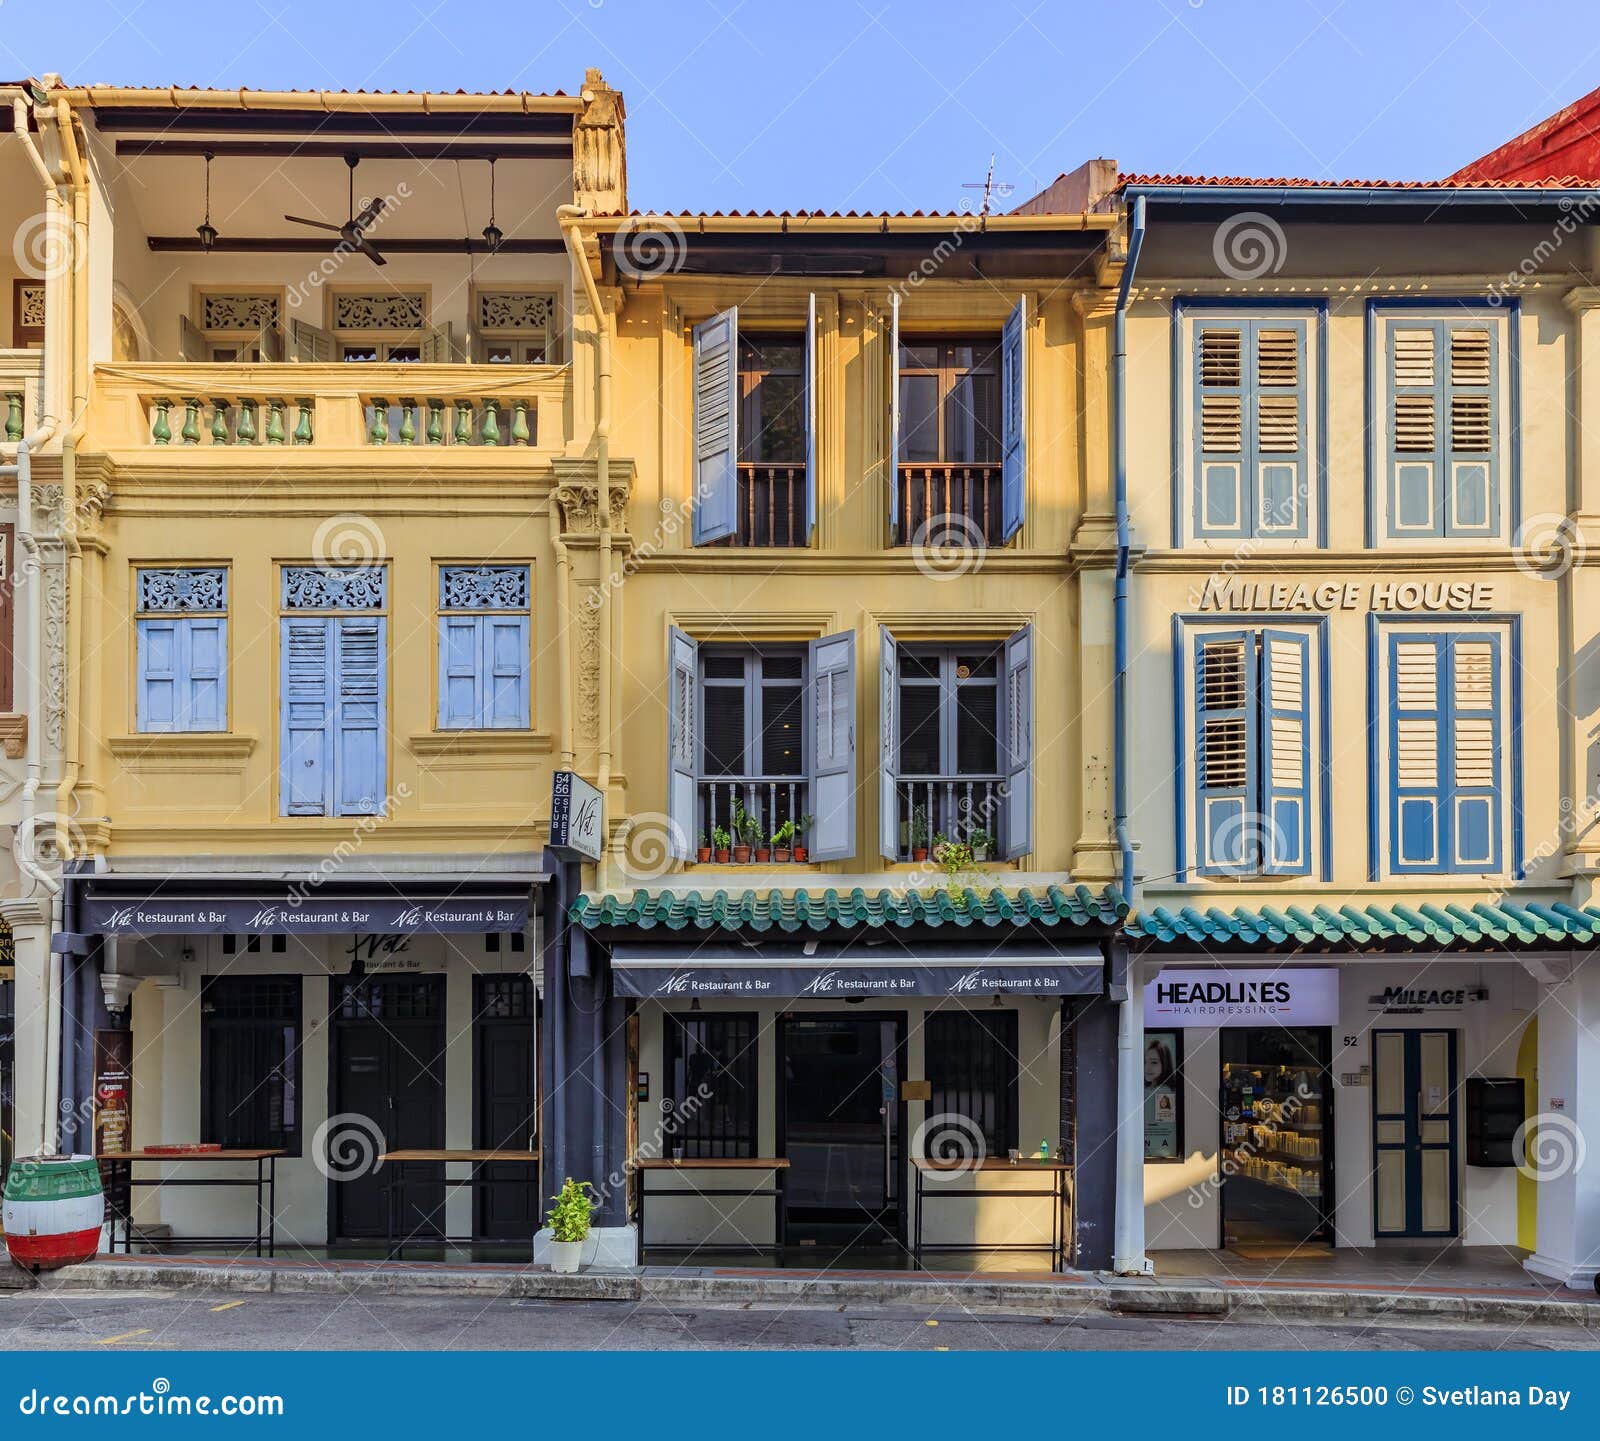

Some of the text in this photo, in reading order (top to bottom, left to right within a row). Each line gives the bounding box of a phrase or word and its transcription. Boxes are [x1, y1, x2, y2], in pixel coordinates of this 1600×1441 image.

[1370, 582, 1496, 611] HOUSE
[556, 773, 569, 784] 54
[555, 784, 569, 794] 56
[552, 798, 561, 829] CLUB
[560, 798, 569, 845] STREET
[137, 912, 195, 923] Restaurant
[198, 912, 206, 923] &
[209, 912, 227, 923] Bar
[281, 911, 339, 923] Restaurant
[341, 911, 350, 923] &
[352, 911, 370, 923] Bar
[425, 911, 482, 922] Restaurant
[485, 911, 494, 922] &
[497, 911, 515, 922] Bar
[691, 981, 742, 990] Restaurant
[745, 980, 753, 989] &
[755, 980, 771, 989] Bar
[837, 979, 888, 989] Restaurant
[890, 979, 898, 988] &
[900, 979, 916, 988] Bar
[982, 978, 1032, 988] Restaurant
[1034, 978, 1042, 987] &
[1044, 978, 1060, 987] Bar
[1157, 982, 1291, 1004] HEADLINES
[1173, 1006, 1277, 1015] HAIRDRESSING
[1343, 1036, 1358, 1047] 52
